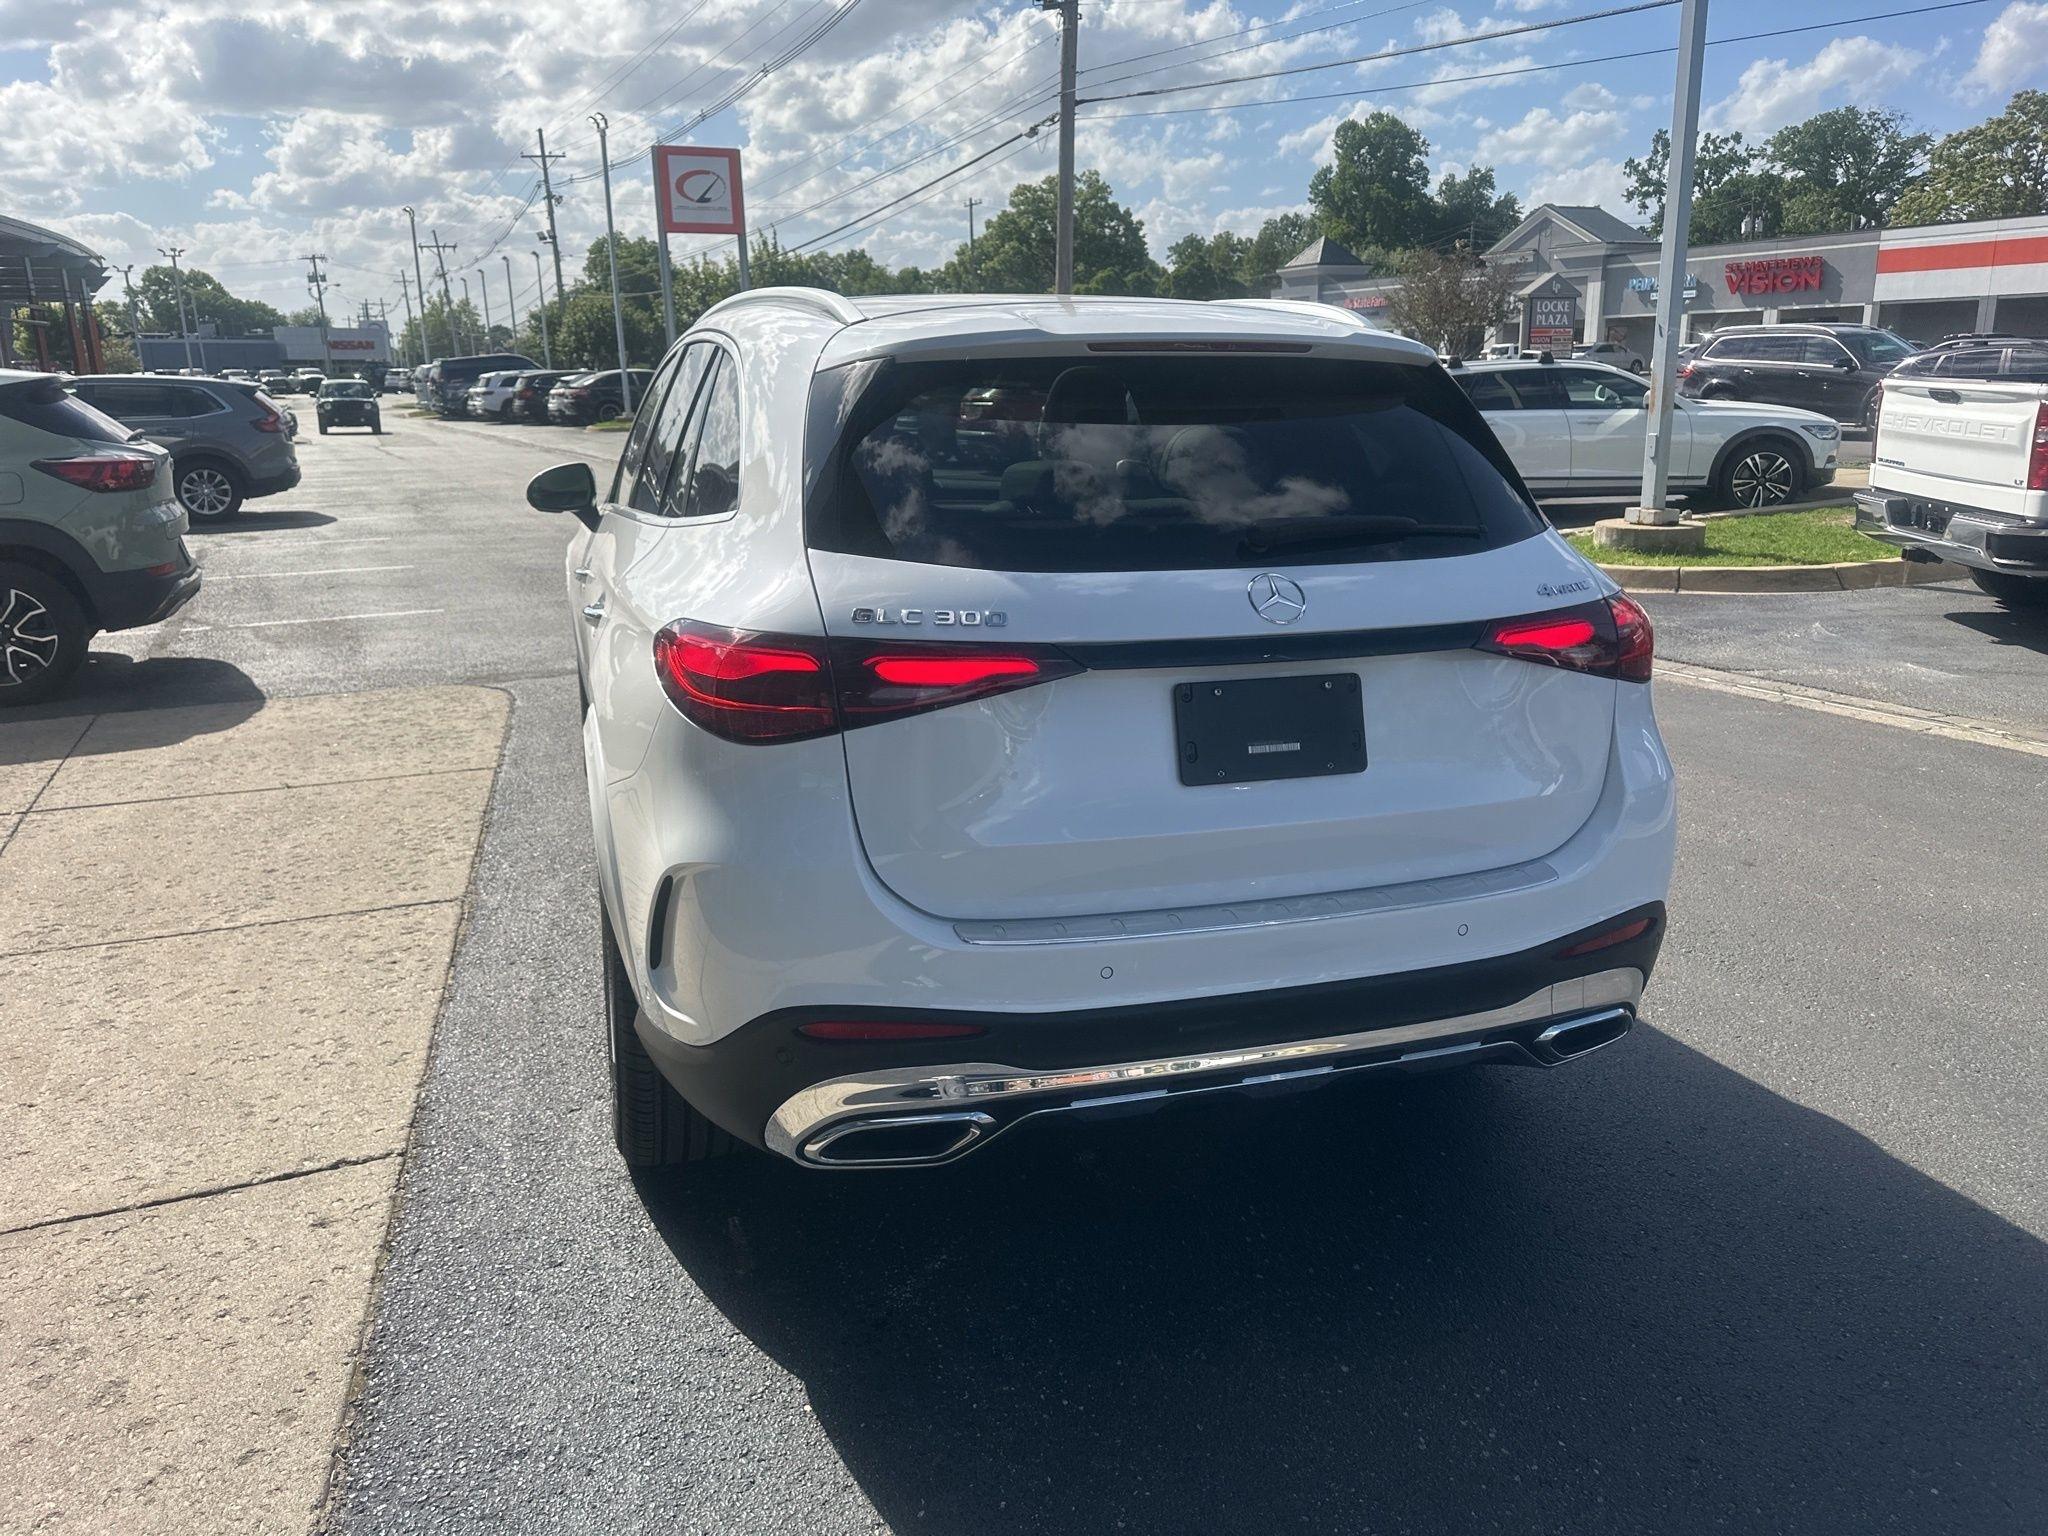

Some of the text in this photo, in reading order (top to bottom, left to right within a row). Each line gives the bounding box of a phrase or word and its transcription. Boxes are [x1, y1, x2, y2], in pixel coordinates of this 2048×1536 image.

[1725, 269, 1824, 295] VISION
[1537, 301, 1570, 312] LOCKE
[1536, 314, 1568, 326] PLAZA
[1531, 336, 1551, 344] VISION
[1882, 412, 2016, 440] CHEVROLET
[851, 607, 1008, 627] GLC 300
